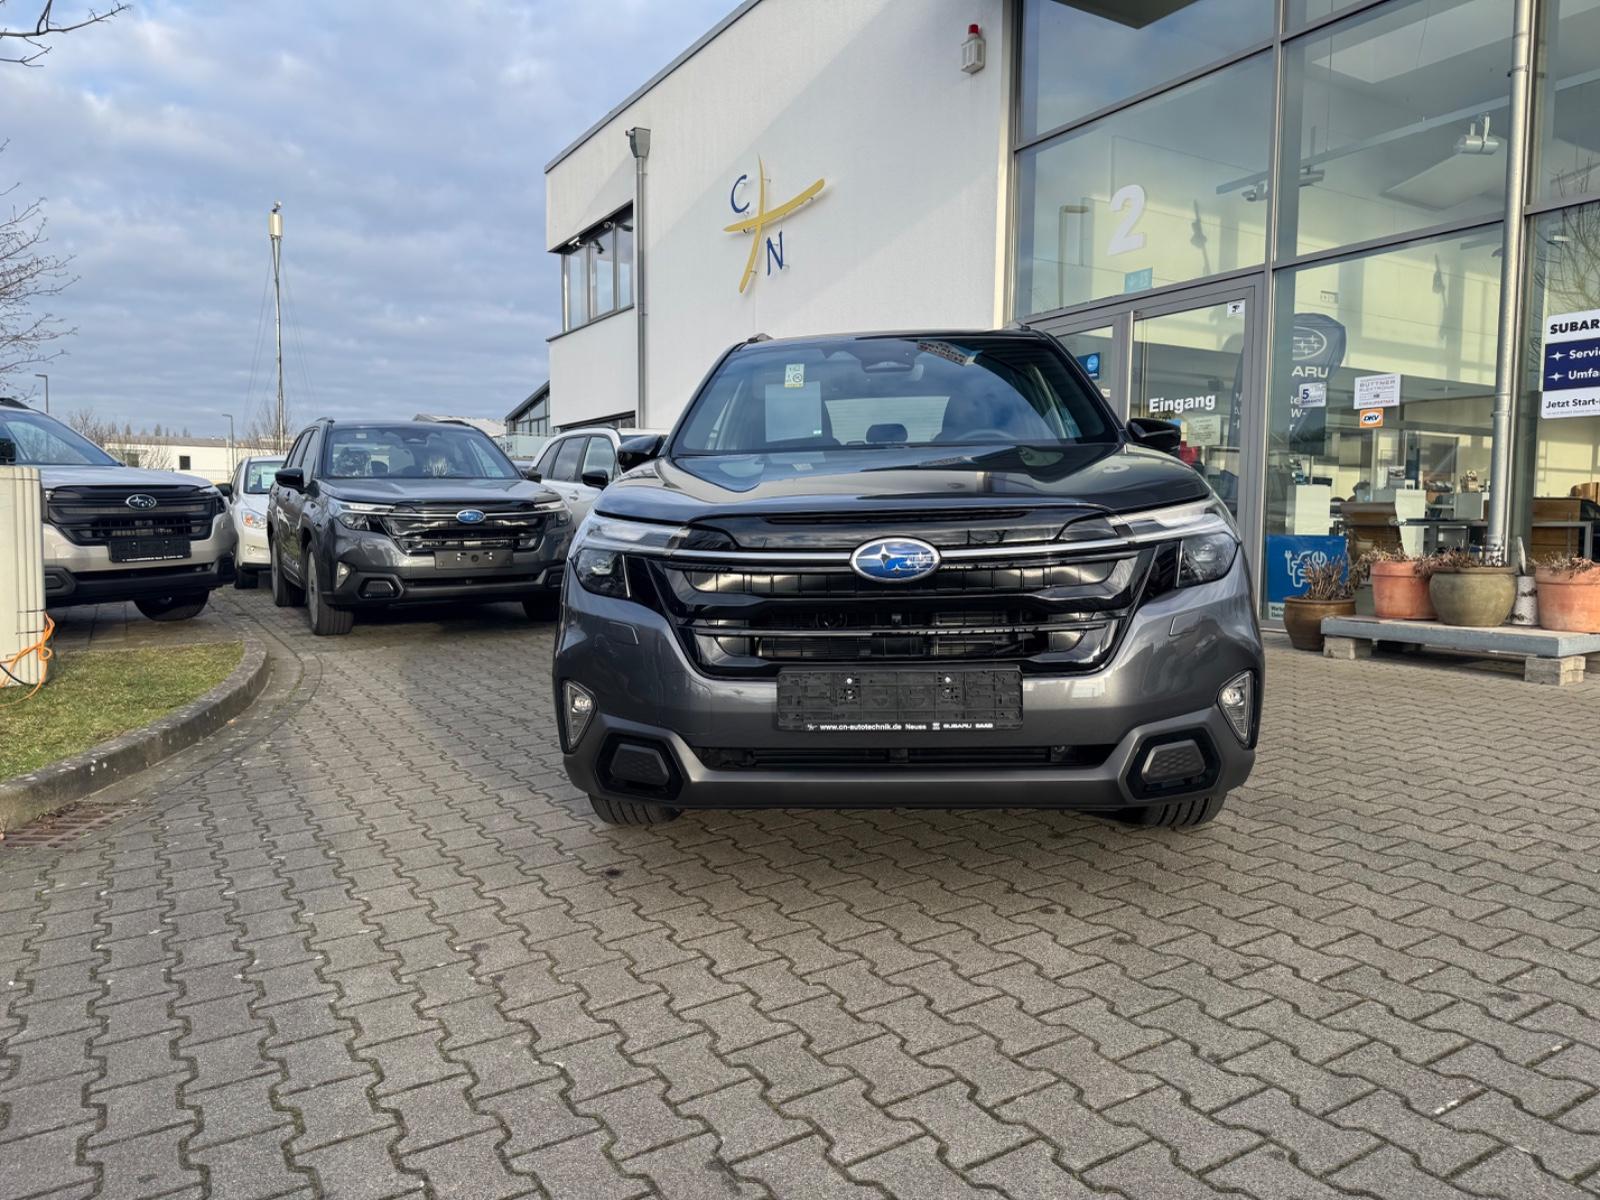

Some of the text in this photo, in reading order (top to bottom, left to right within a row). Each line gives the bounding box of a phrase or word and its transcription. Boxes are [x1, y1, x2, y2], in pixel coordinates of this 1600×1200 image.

[730, 174, 750, 213] C
[1107, 184, 1145, 256] 2
[766, 230, 784, 276] N
[1569, 346, 1600, 359] Servi
[1568, 368, 1600, 380] Umfa
[1302, 388, 1309, 400] 5
[1149, 394, 1216, 413] Eingang
[1546, 398, 1600, 409] Jetzt Start-
[820, 723, 902, 731] www.cn-autotechnik.de
